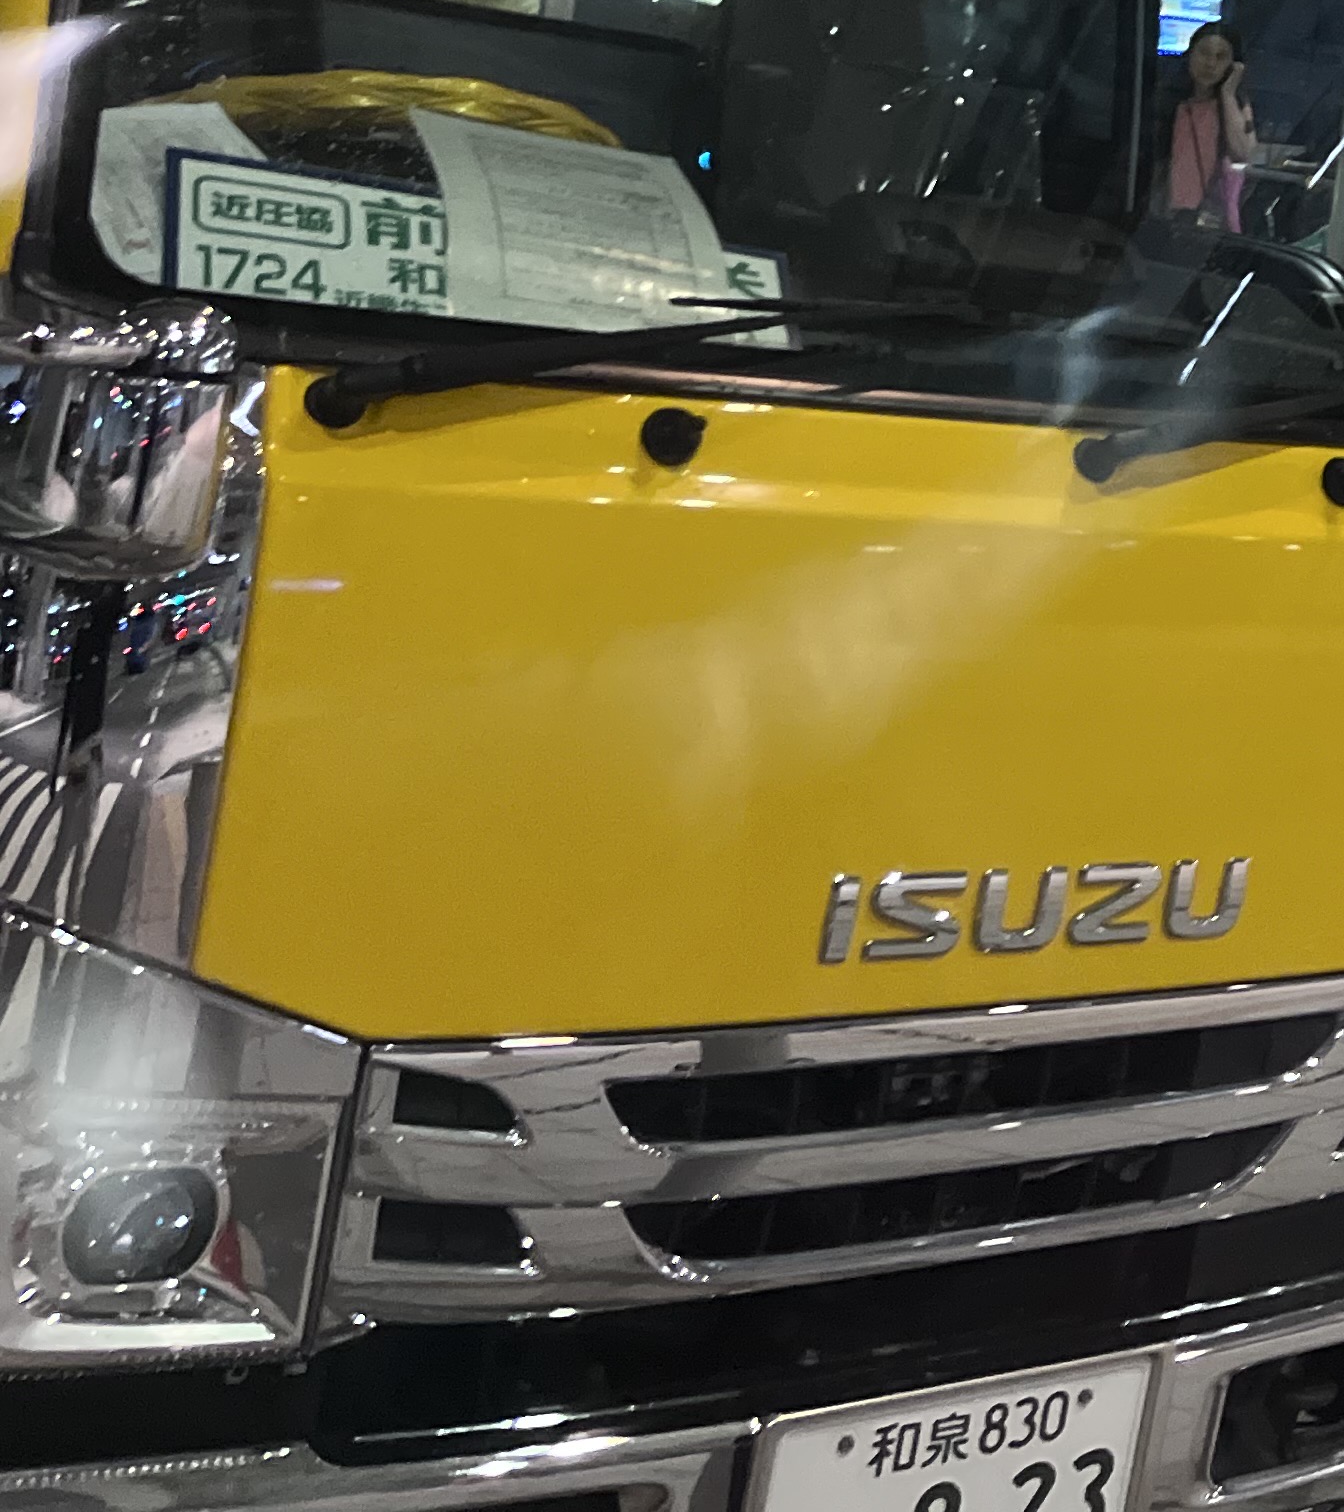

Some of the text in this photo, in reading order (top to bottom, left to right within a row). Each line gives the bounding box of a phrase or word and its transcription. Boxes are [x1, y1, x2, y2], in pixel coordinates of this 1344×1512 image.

[196, 242, 328, 301] 1724
[387, 257, 448, 299] 和
[818, 856, 1252, 964] ISUZU
